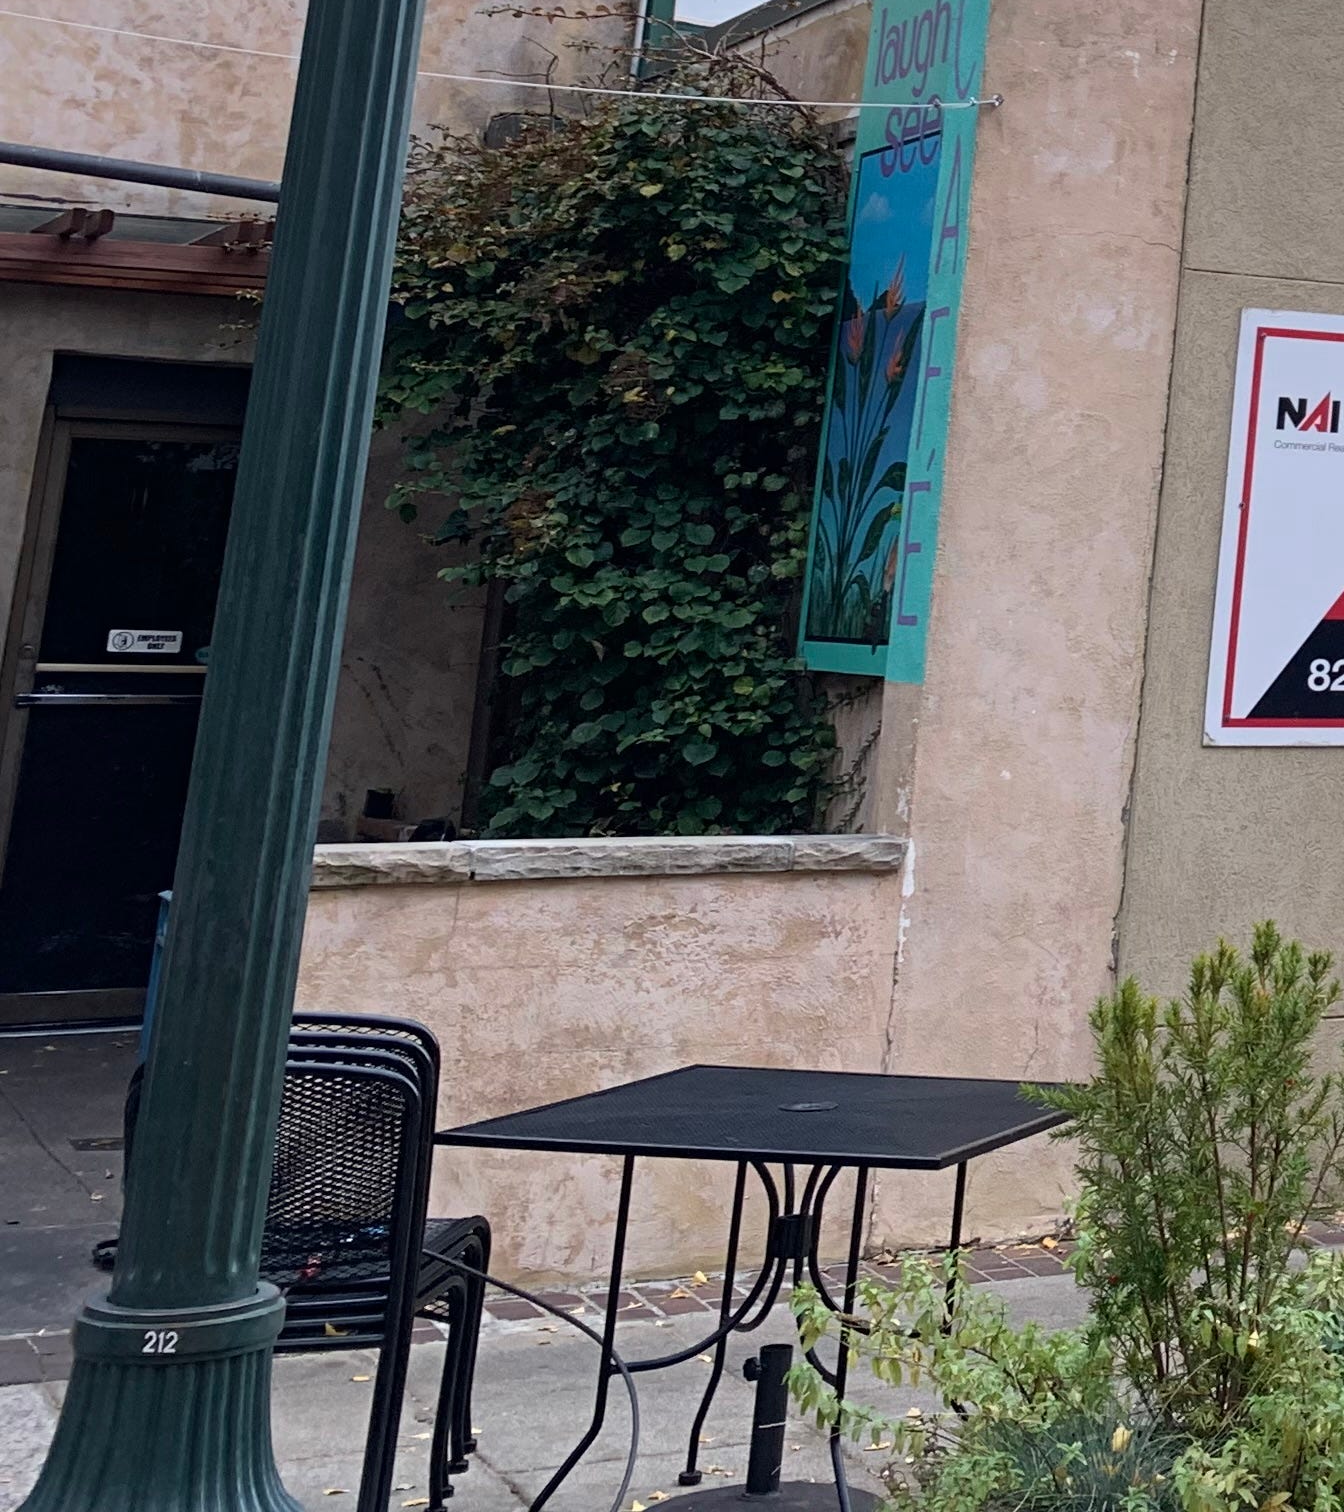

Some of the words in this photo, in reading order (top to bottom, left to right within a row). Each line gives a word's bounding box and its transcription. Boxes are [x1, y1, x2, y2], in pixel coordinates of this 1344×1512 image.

[1276, 391, 1341, 433] NAI
[1274, 440, 1326, 451] Commercial
[142, 1330, 178, 1353] 212
